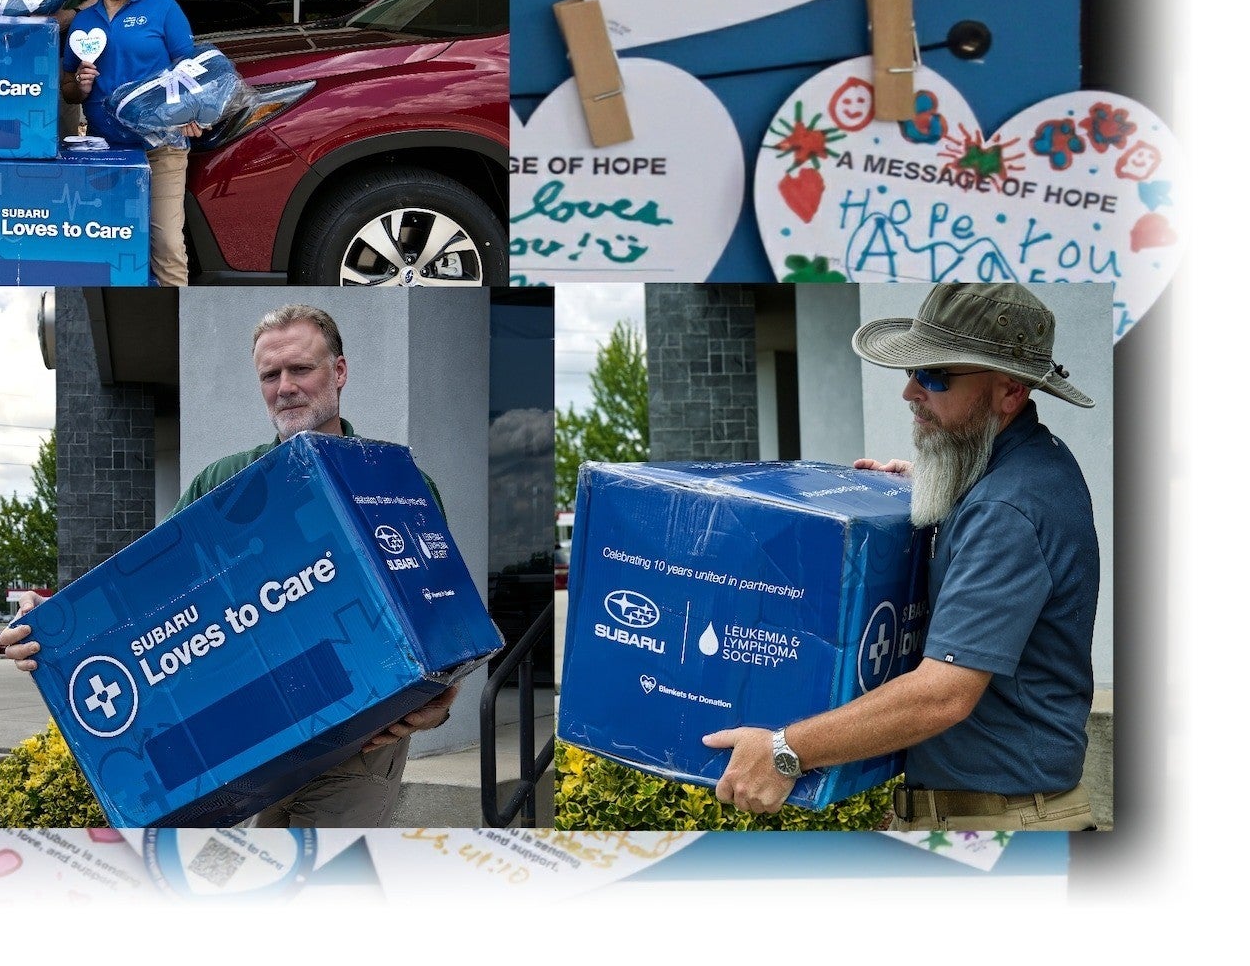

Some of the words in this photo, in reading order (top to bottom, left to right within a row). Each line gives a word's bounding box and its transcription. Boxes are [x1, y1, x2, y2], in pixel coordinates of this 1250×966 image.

[548, 157, 584, 175] OF
[593, 158, 666, 175] HOPE
[836, 152, 854, 171] A
[863, 155, 993, 194] MESSAGE
[1002, 180, 1036, 198] OF
[1044, 186, 1118, 214] HOPE
[1, 208, 50, 218] SUBARU
[2, 220, 58, 236] Loves
[62, 221, 80, 237] to
[84, 222, 132, 240] Care
[602, 547, 651, 570] Celebrating
[654, 559, 666, 572] 10
[666, 564, 694, 578] years
[694, 571, 726, 585] united
[728, 576, 738, 586] in
[739, 578, 805, 600] partnership!
[131, 605, 200, 658] SUBARU
[137, 626, 227, 688] Loves
[224, 606, 259, 637] to
[258, 555, 336, 617] Care
[594, 624, 664, 654] SUBARU
[725, 624, 788, 645] LEUKEMIA
[790, 636, 800, 648] &
[722, 650, 780, 668] SOCIETY
[724, 637, 798, 660] LYMPHOMA
[658, 685, 687, 699] Blankets
[688, 693, 698, 702] for
[699, 695, 732, 708] Donation
